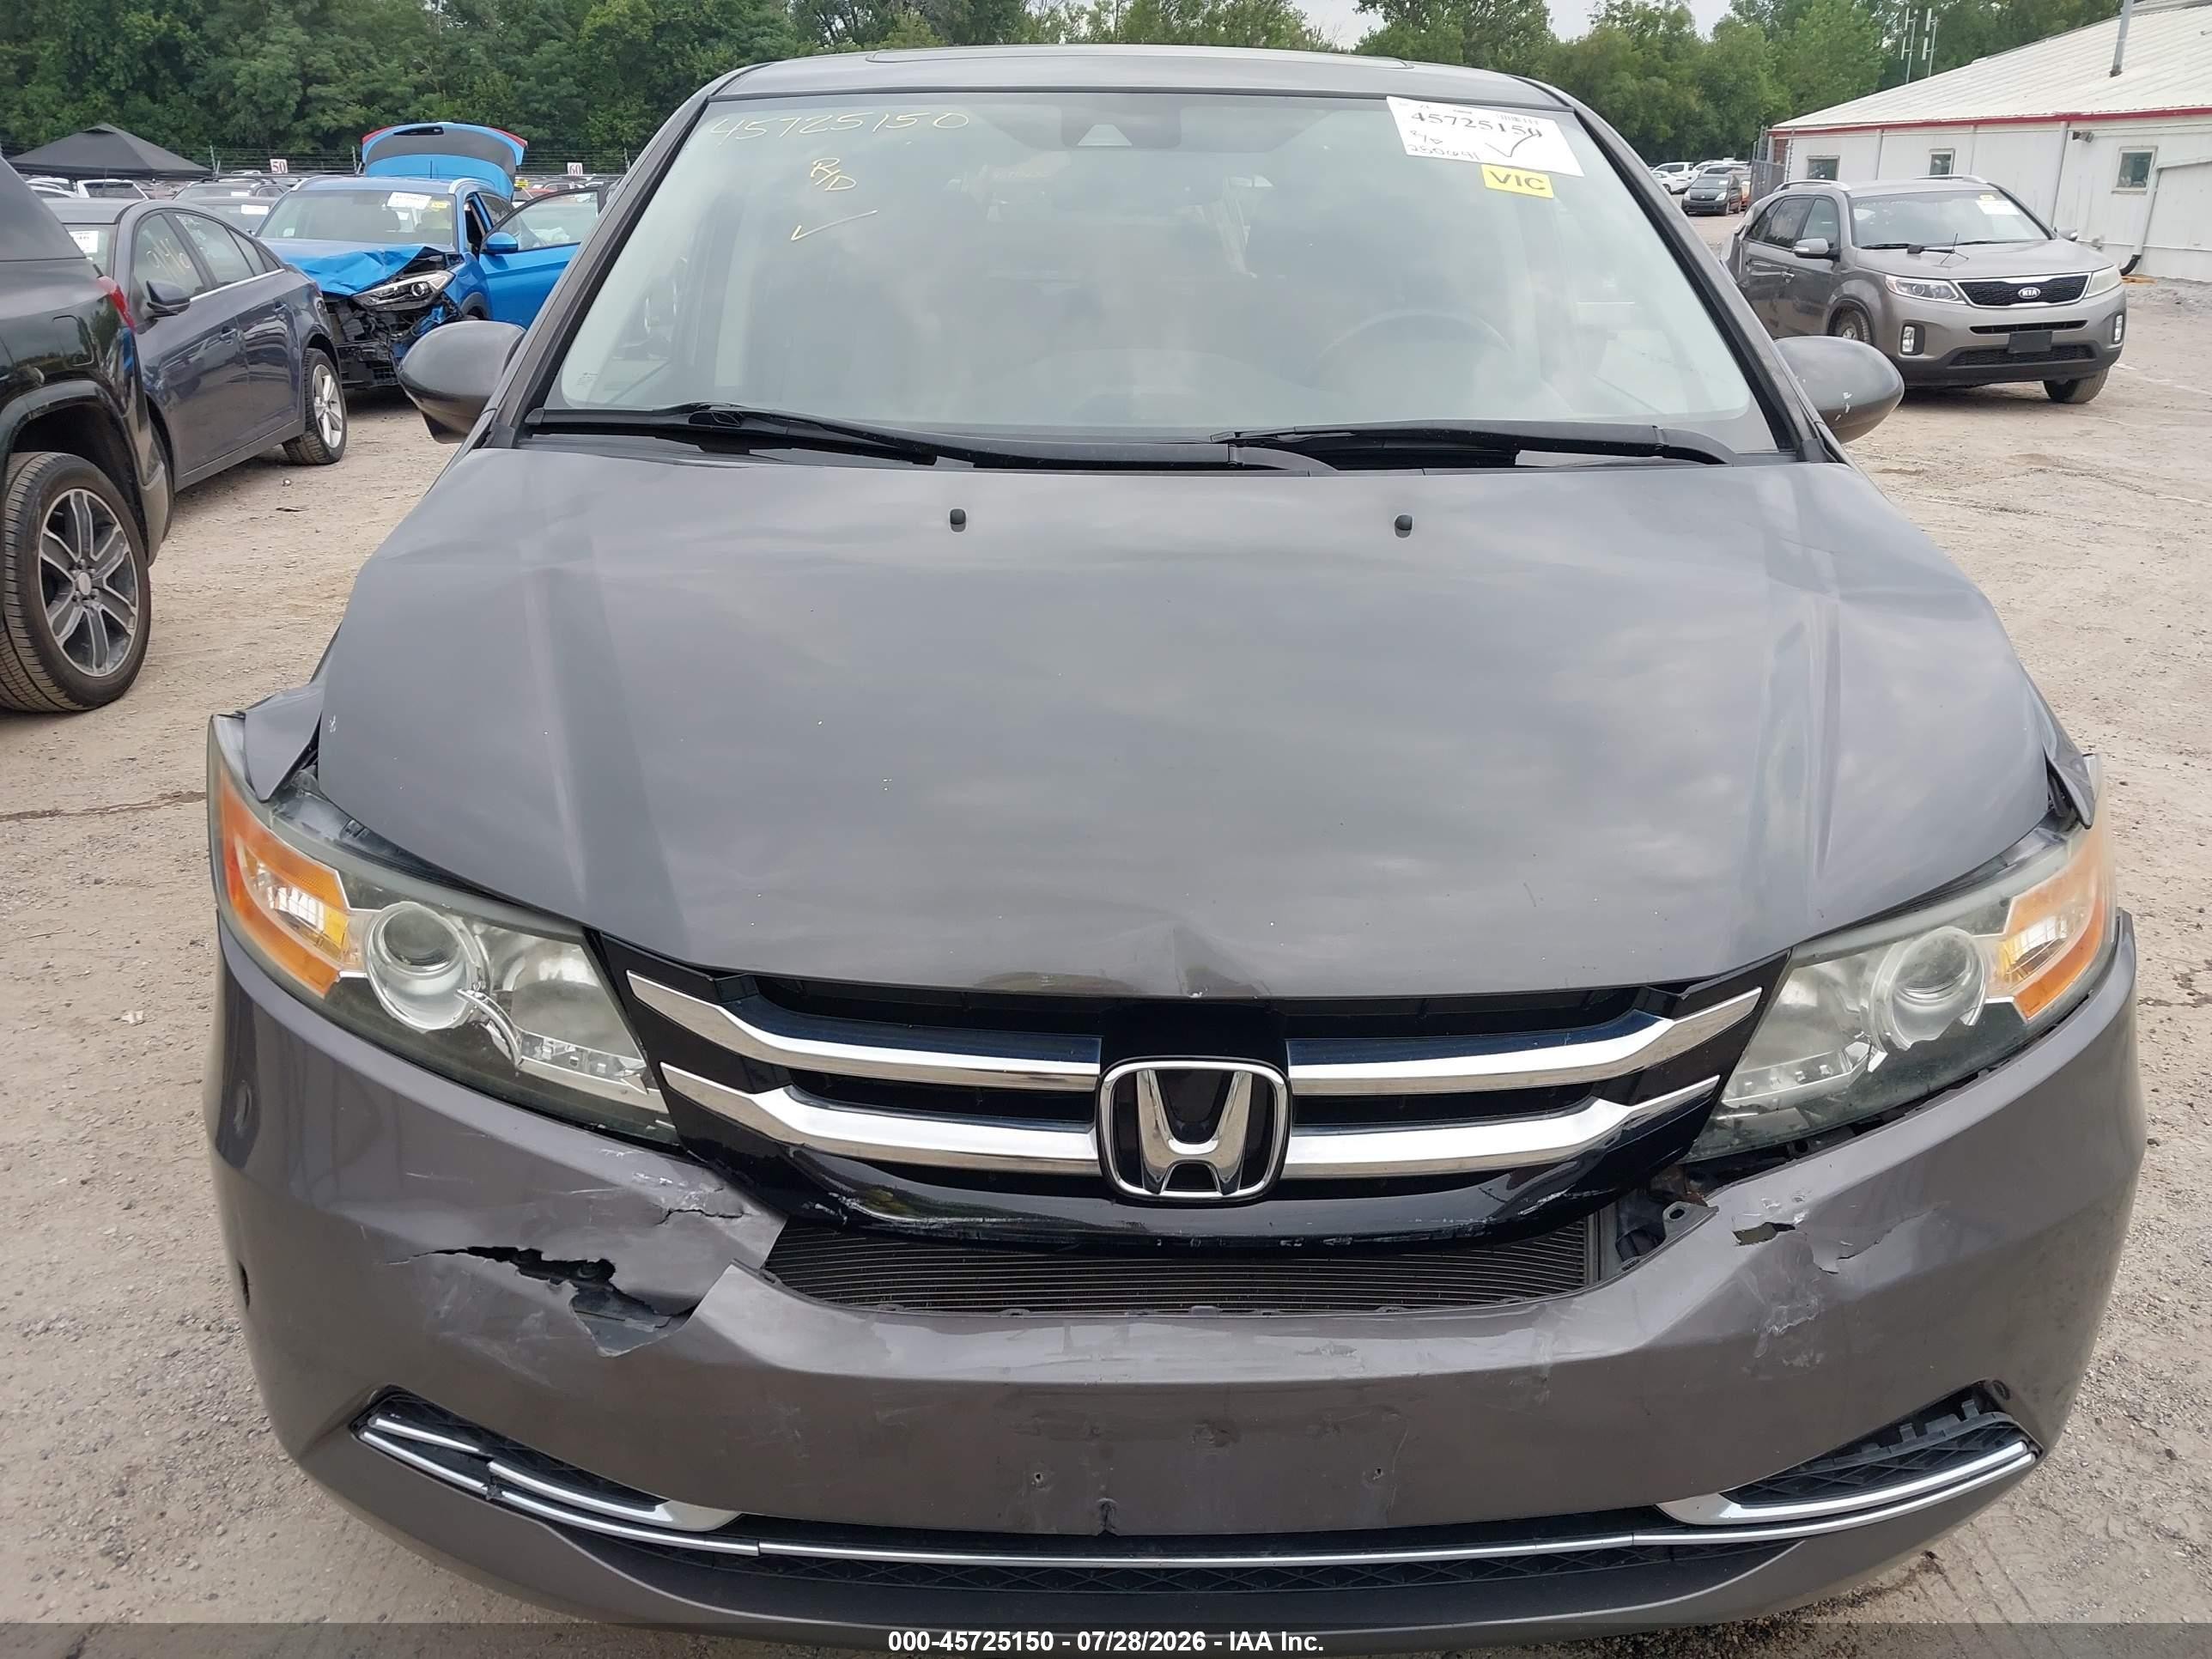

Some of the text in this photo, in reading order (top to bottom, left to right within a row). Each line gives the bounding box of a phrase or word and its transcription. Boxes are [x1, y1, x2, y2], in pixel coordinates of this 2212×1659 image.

[709, 112, 969, 147] 45725150
[272, 161, 286, 173] 50
[569, 164, 581, 175] 60
[1489, 170, 1547, 191] VIC
